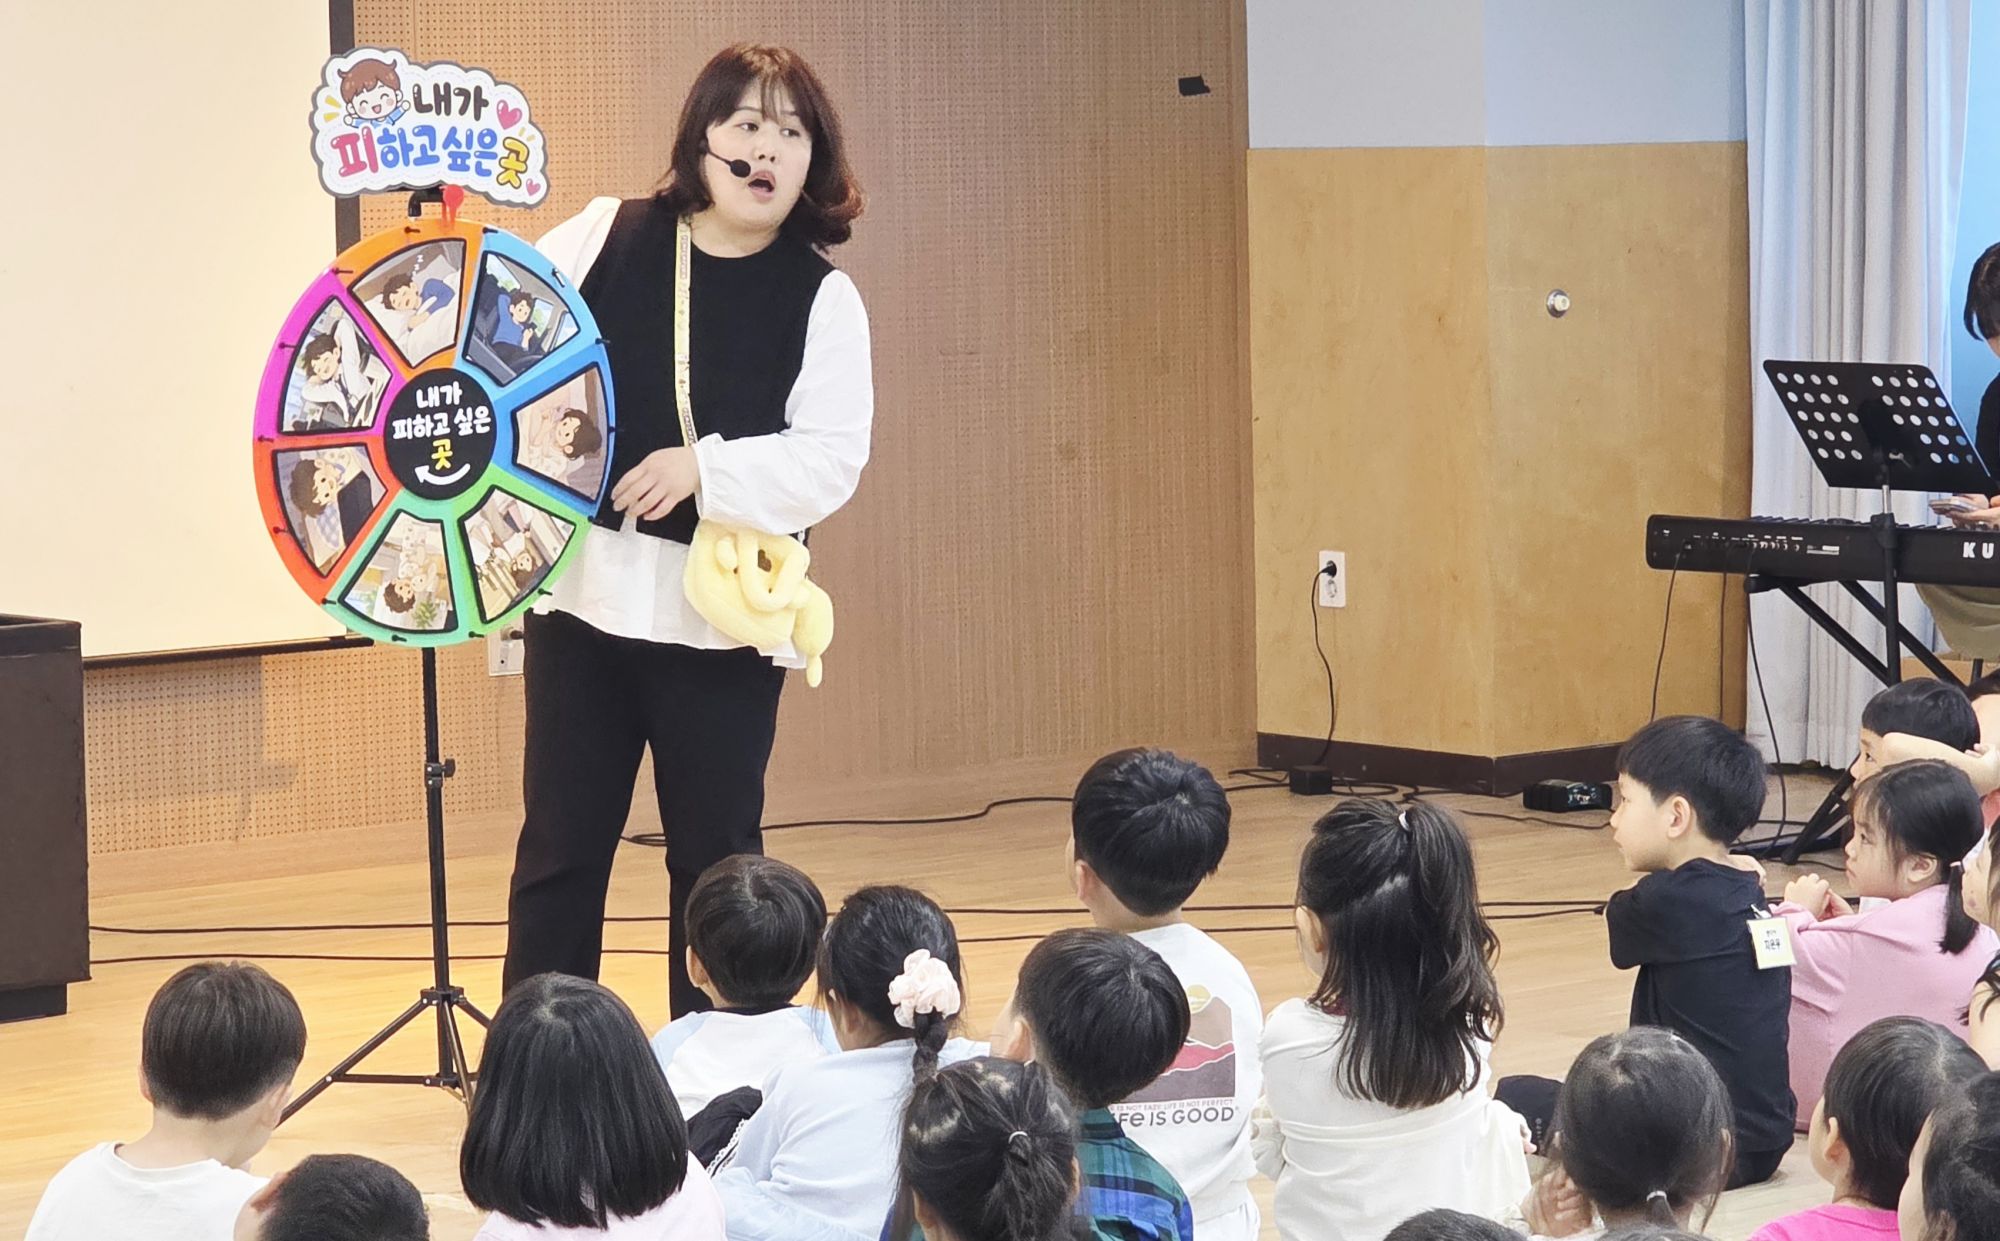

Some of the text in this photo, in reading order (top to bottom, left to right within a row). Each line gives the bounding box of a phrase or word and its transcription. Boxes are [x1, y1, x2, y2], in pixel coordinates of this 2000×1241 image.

[412, 82, 489, 121] 내가
[330, 125, 529, 188] 피하고 싶은 곳
[416, 381, 463, 408] 내가
[392, 405, 491, 439] 피하고 싶은
[431, 439, 453, 470] 곳
[1963, 541, 1994, 559] KU
[1149, 1111, 1166, 1126] IS
[1172, 1106, 1234, 1124] GOOD
[1186, 1100, 1200, 1108] NOT
[1201, 1098, 1233, 1106] PERFECT
